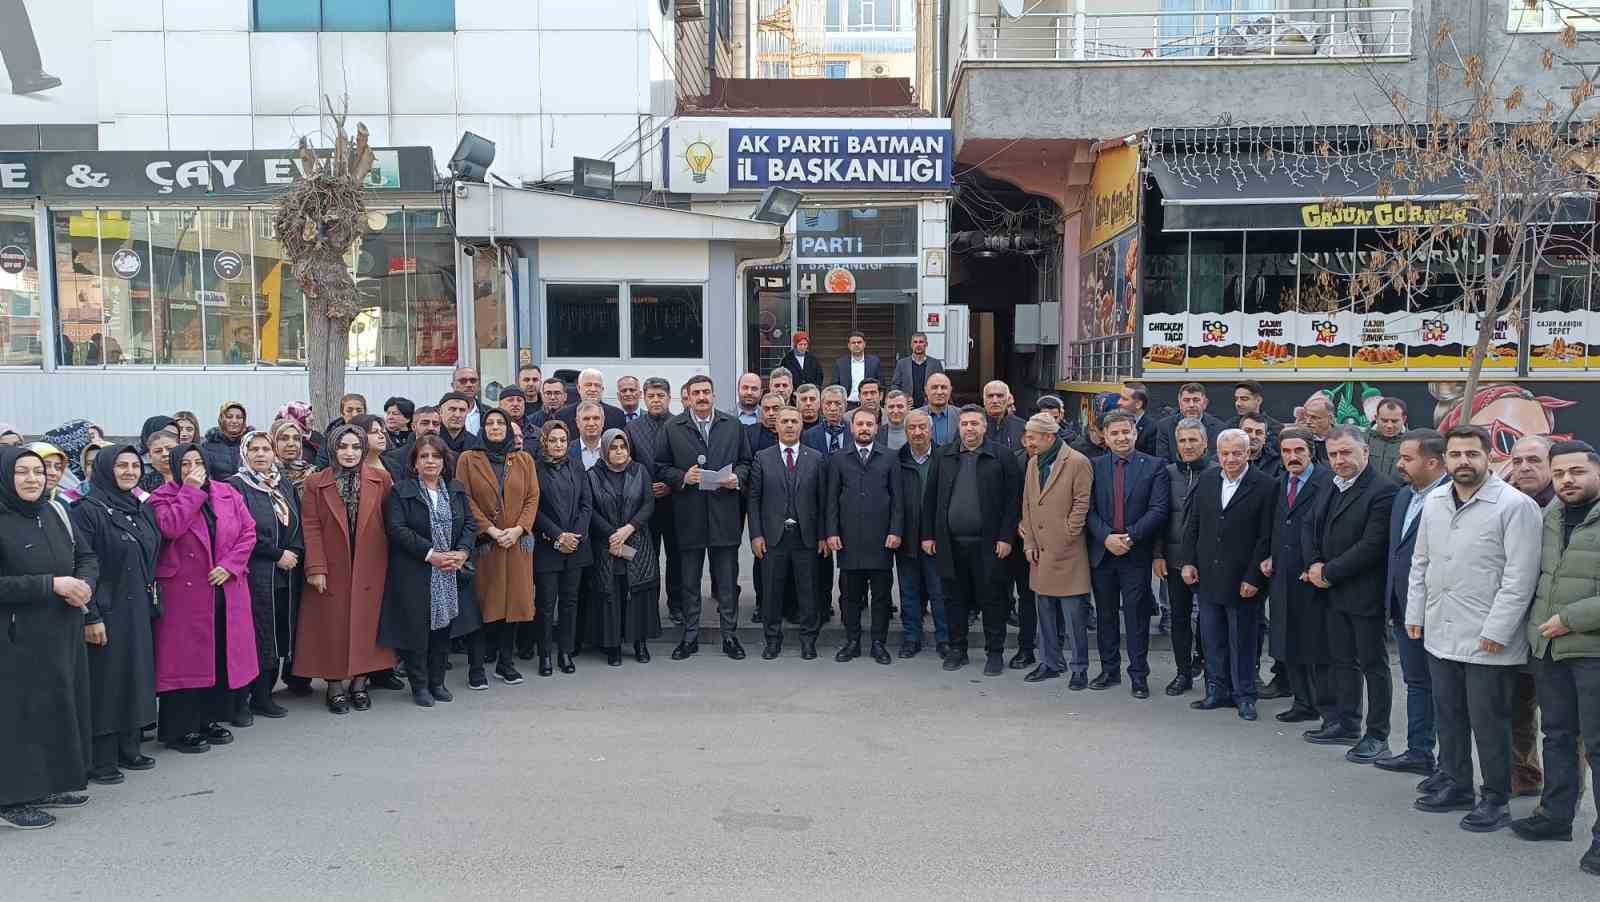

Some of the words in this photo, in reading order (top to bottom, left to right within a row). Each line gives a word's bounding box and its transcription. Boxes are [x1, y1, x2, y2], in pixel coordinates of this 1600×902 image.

[737, 135, 769, 153] AK
[778, 135, 839, 154] PARTİ
[848, 136, 944, 155] BATMAN
[145, 159, 244, 193] ÇAY
[737, 158, 758, 182] İL
[769, 155, 943, 184] BAŞKANLIĞI
[1301, 203, 1373, 228] CAJUN
[1148, 322, 1184, 332] CHICKEN
[1475, 320, 1508, 332] CUN
[1164, 332, 1184, 343] TACO
[1202, 332, 1226, 343] LOVE
